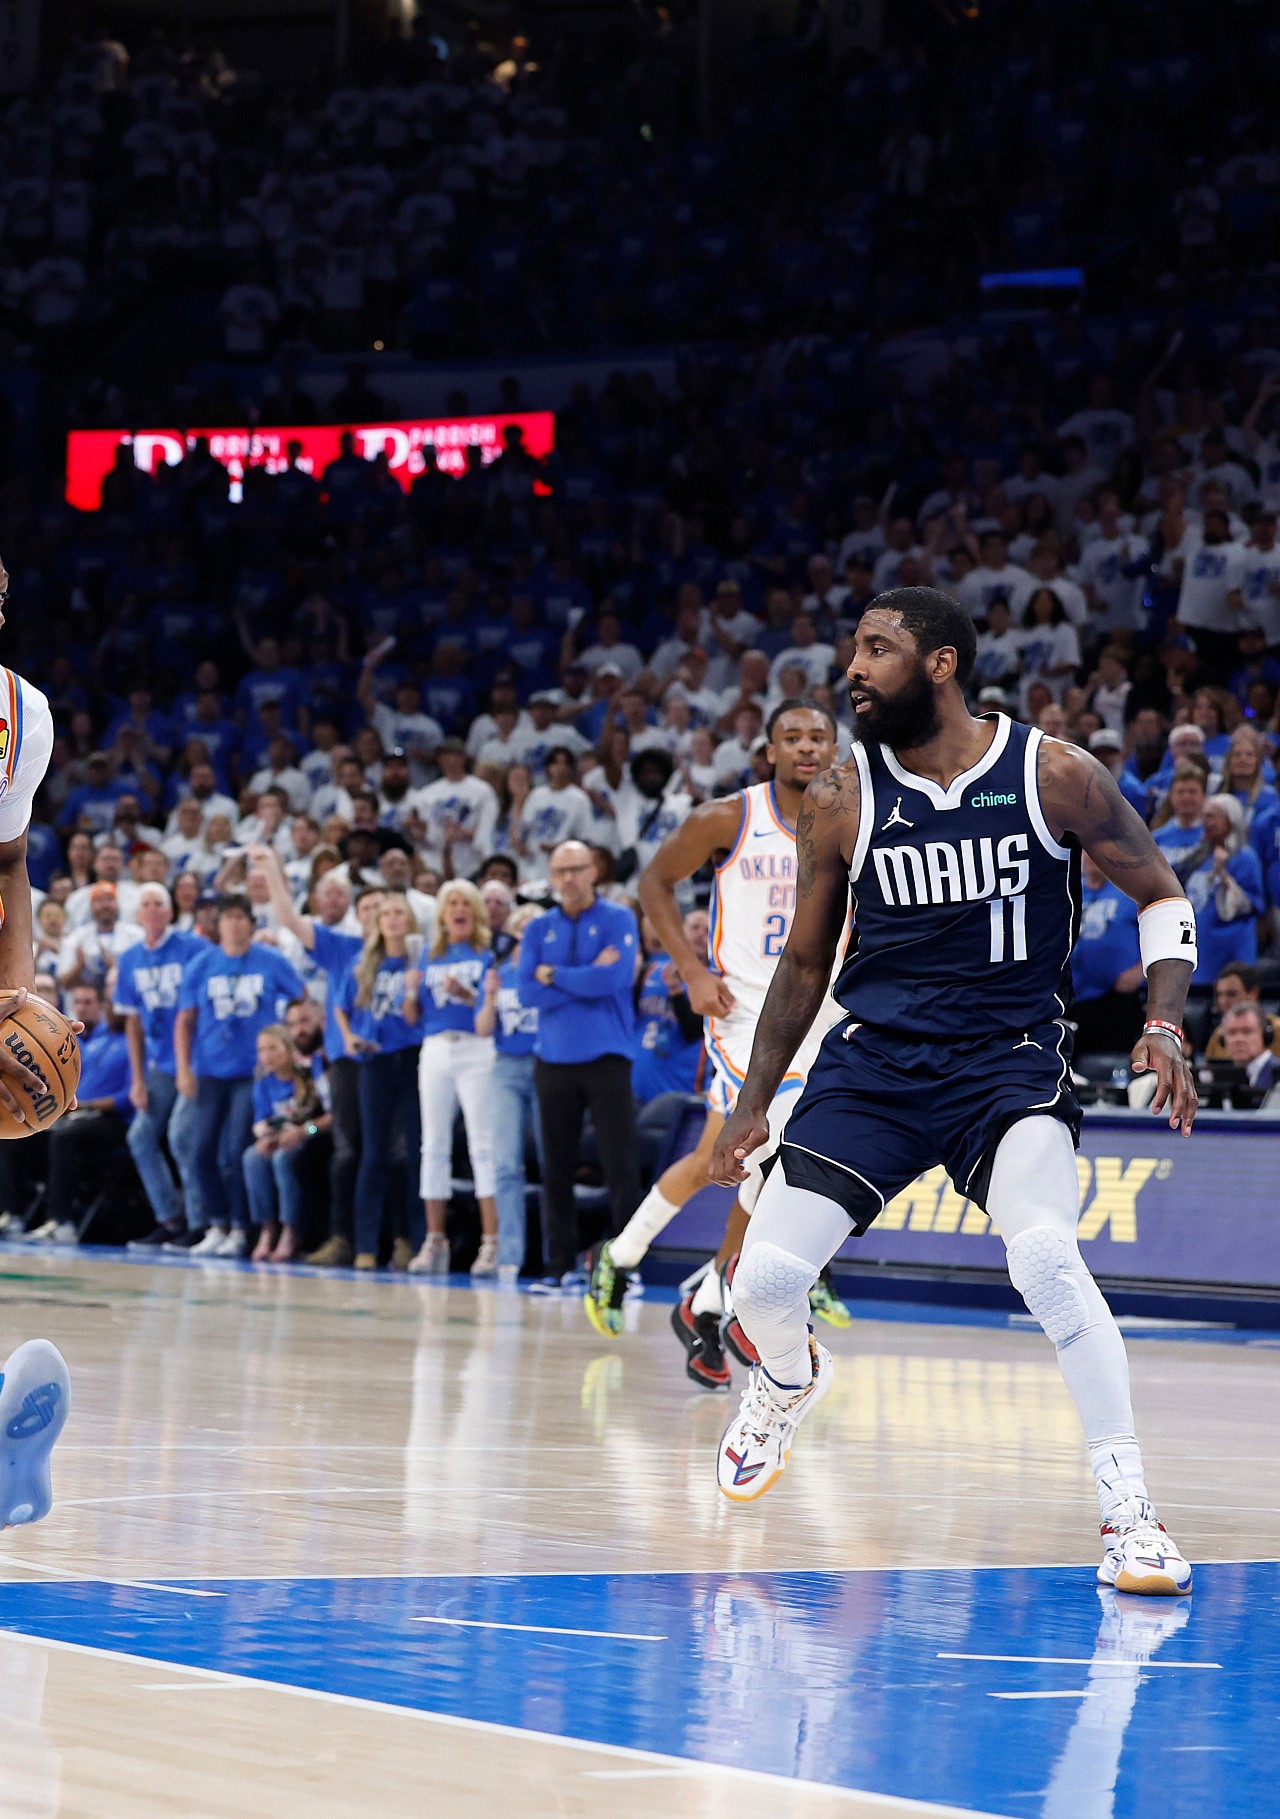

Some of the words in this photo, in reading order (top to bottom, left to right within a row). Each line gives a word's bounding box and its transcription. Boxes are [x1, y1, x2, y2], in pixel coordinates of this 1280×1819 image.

[971, 791, 1017, 808] chime
[738, 854, 798, 881] OKLA
[872, 833, 1030, 906] MAVS
[760, 912, 790, 959] 2
[985, 894, 1028, 963] 11
